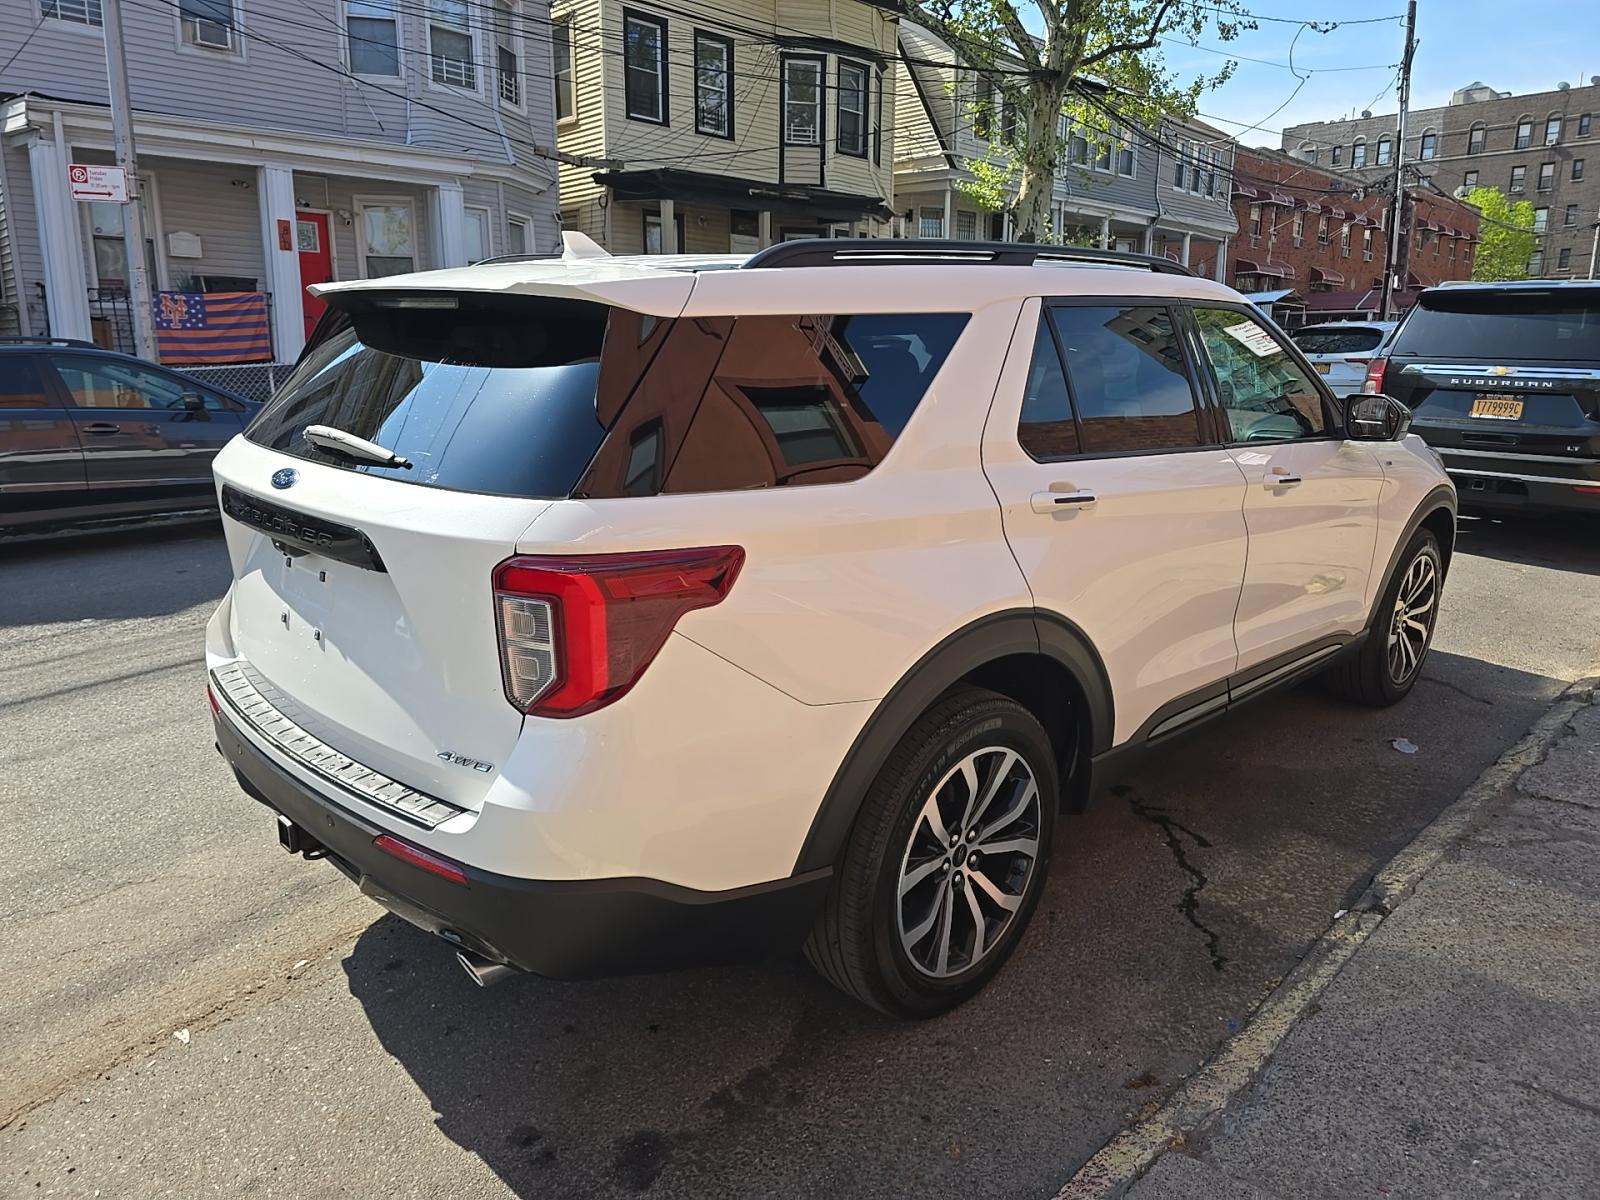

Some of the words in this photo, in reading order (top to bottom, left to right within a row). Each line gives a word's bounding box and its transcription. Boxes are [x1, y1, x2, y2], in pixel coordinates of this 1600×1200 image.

[1450, 378, 1553, 388] SUBURBAN
[1476, 401, 1521, 415] T779999C
[1566, 444, 1581, 453] LT
[437, 750, 495, 773] 4WD
